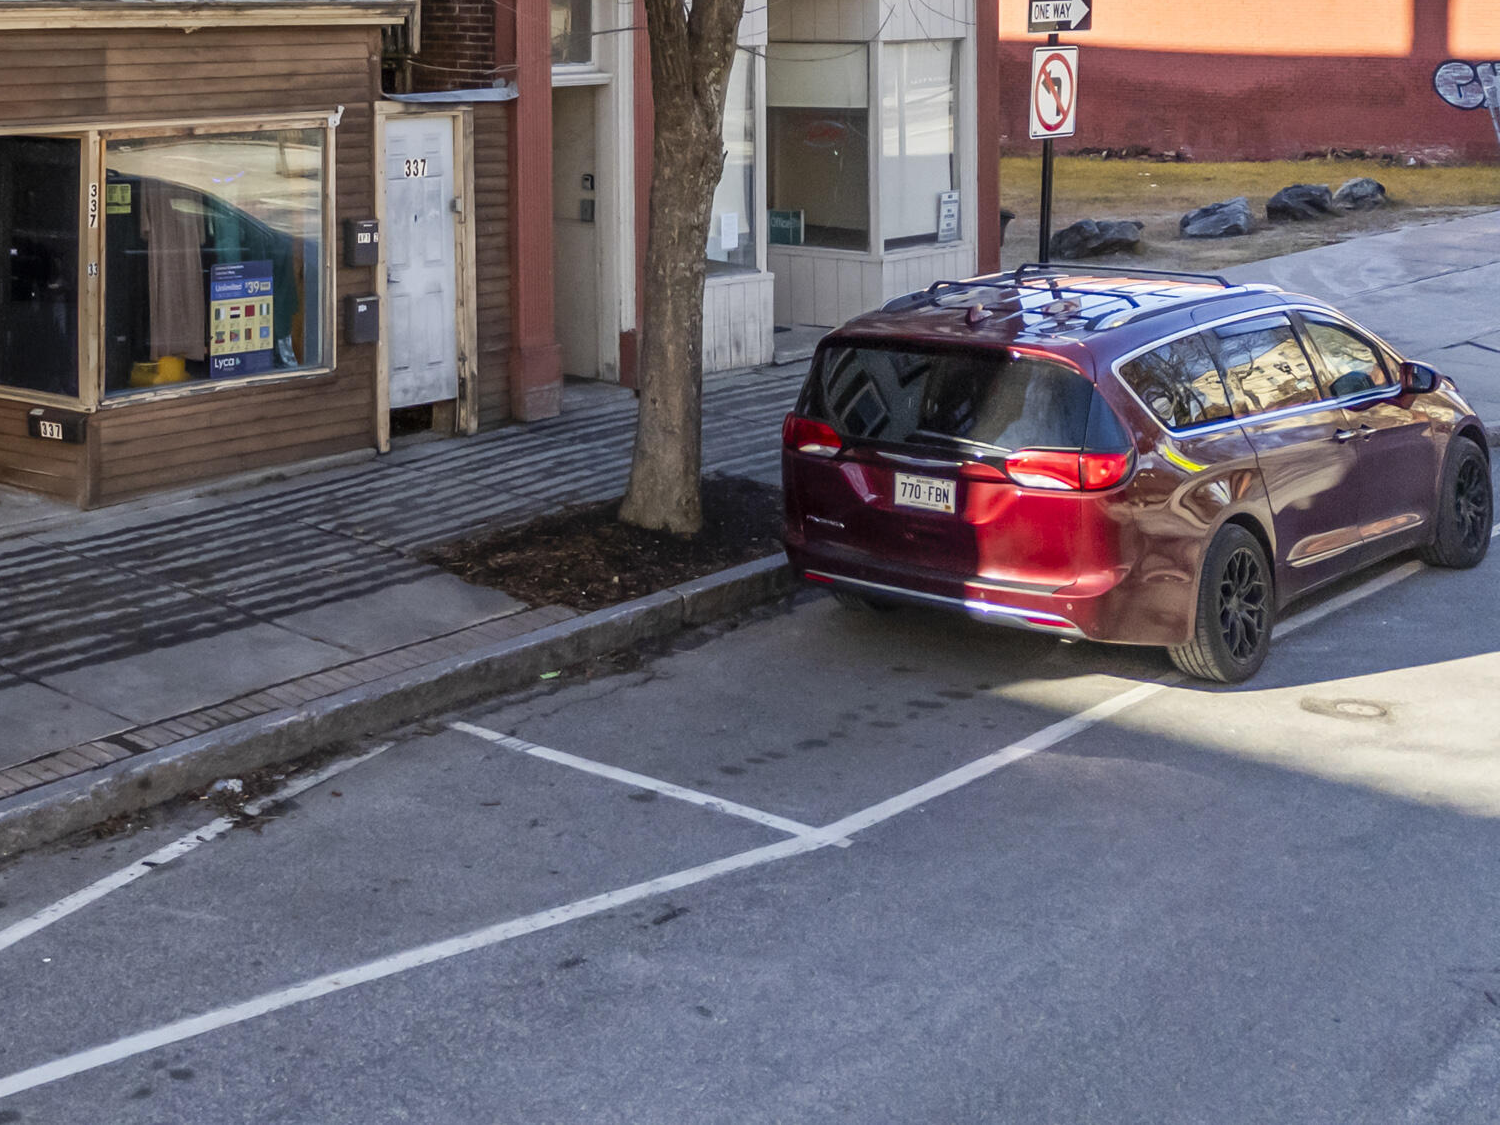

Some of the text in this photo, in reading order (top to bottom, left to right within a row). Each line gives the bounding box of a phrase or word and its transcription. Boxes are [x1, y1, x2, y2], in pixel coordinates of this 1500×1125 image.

[1034, 3, 1072, 20] ONE WAY
[405, 158, 427, 177] 337
[90, 184, 98, 227] 337
[214, 357, 235, 370] Lyca
[42, 422, 61, 438] 337
